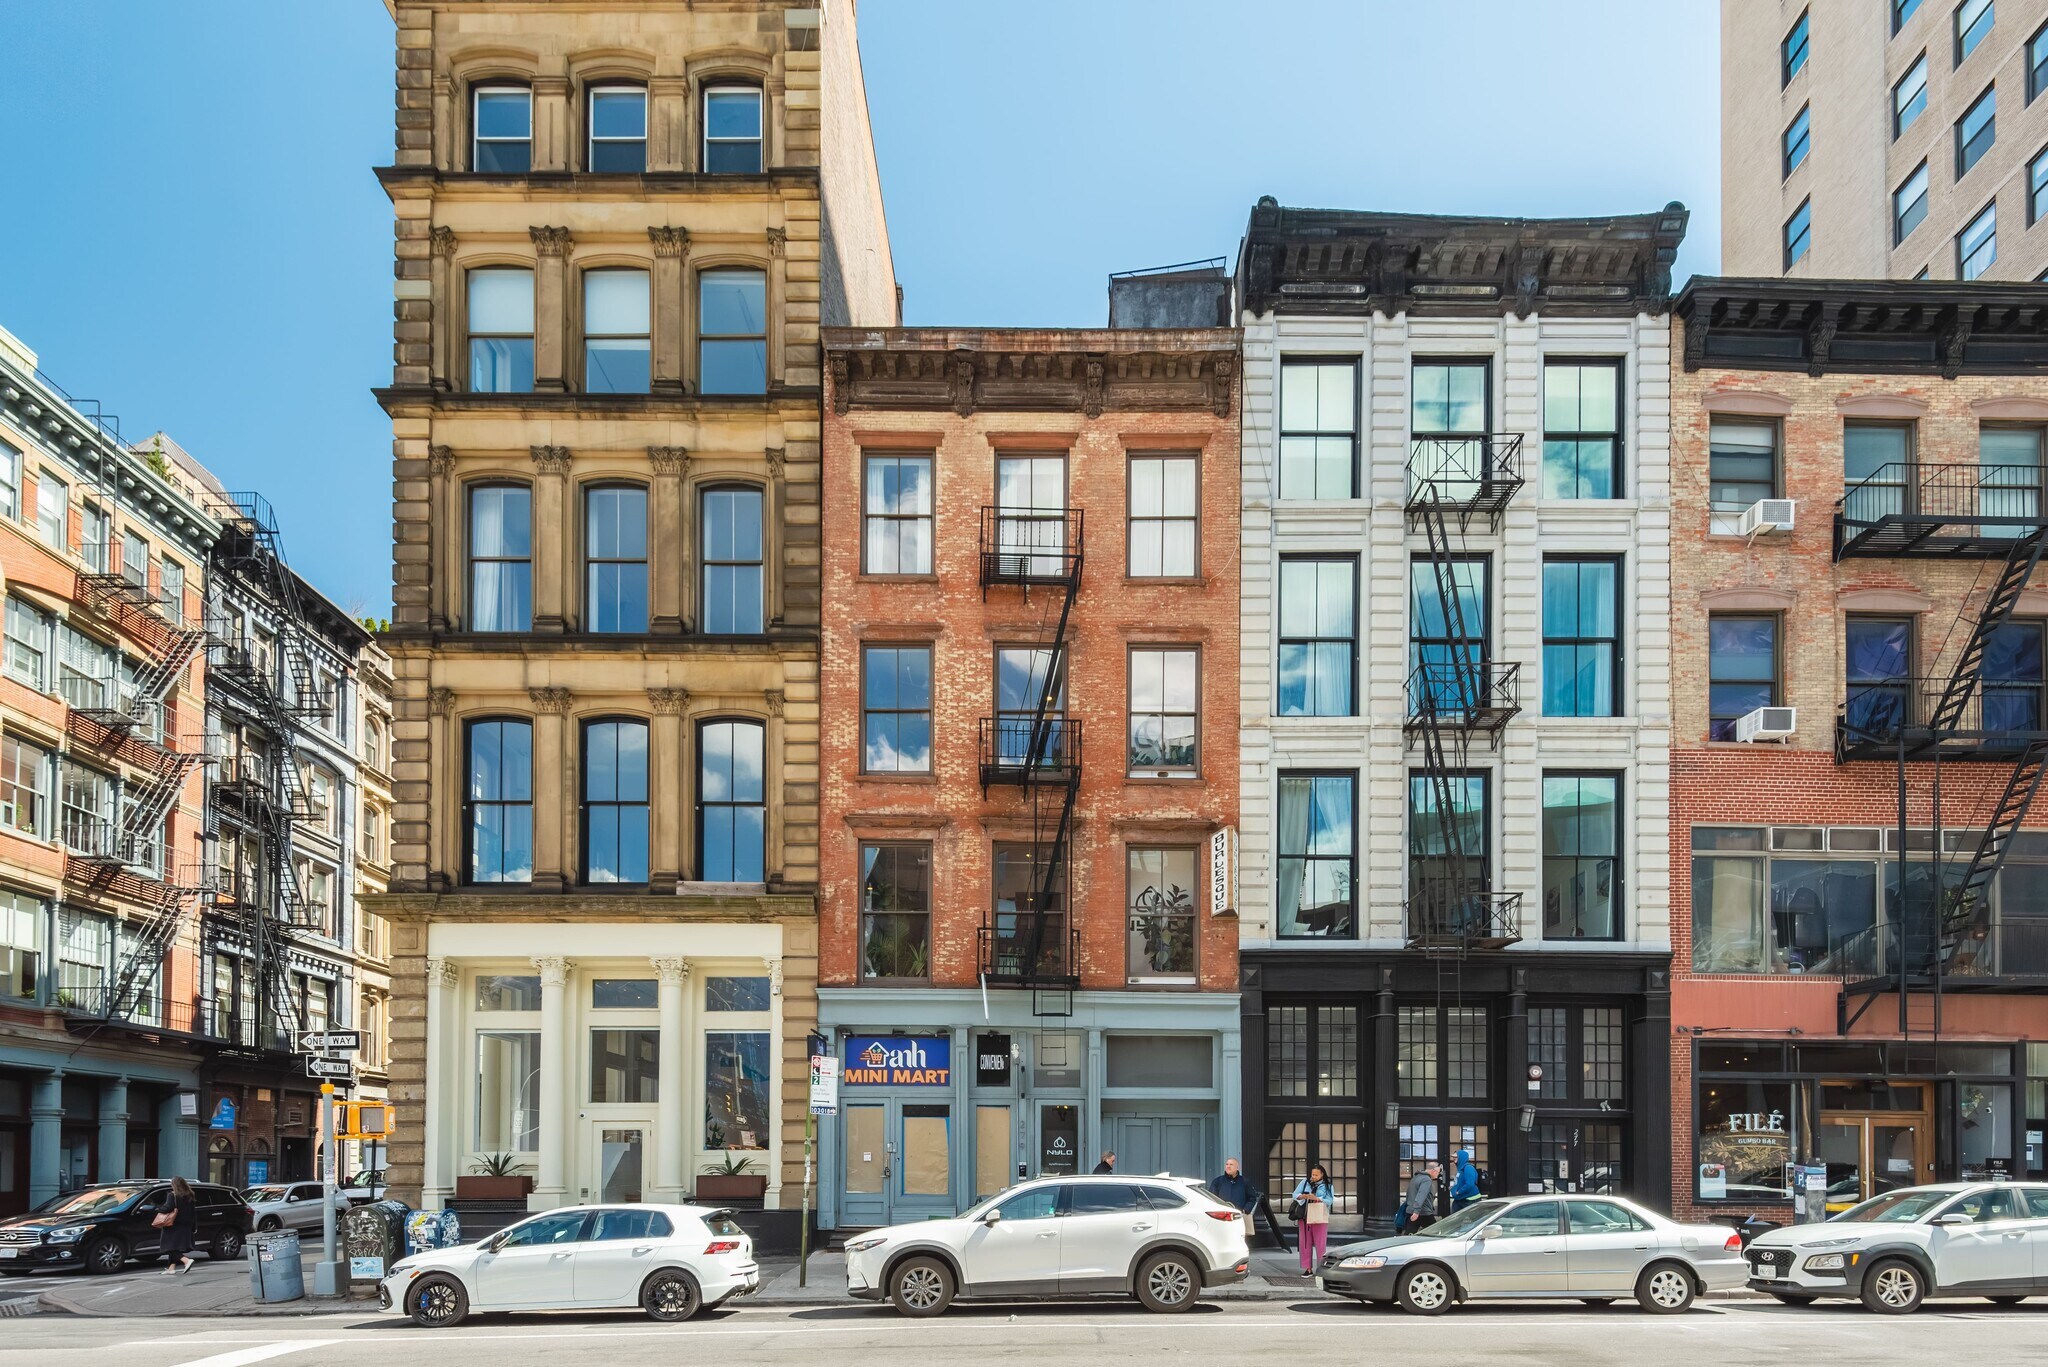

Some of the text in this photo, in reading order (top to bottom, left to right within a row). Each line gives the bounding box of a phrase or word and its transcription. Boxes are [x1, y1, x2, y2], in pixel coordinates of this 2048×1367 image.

[1215, 833, 1224, 910] BURLESQUE
[306, 1037, 351, 1046] ONE WAY
[314, 1062, 345, 1072] ONE WAY
[845, 1069, 887, 1083] MINI
[893, 1069, 949, 1083] MART
[1728, 1109, 1785, 1133] FILÉ
